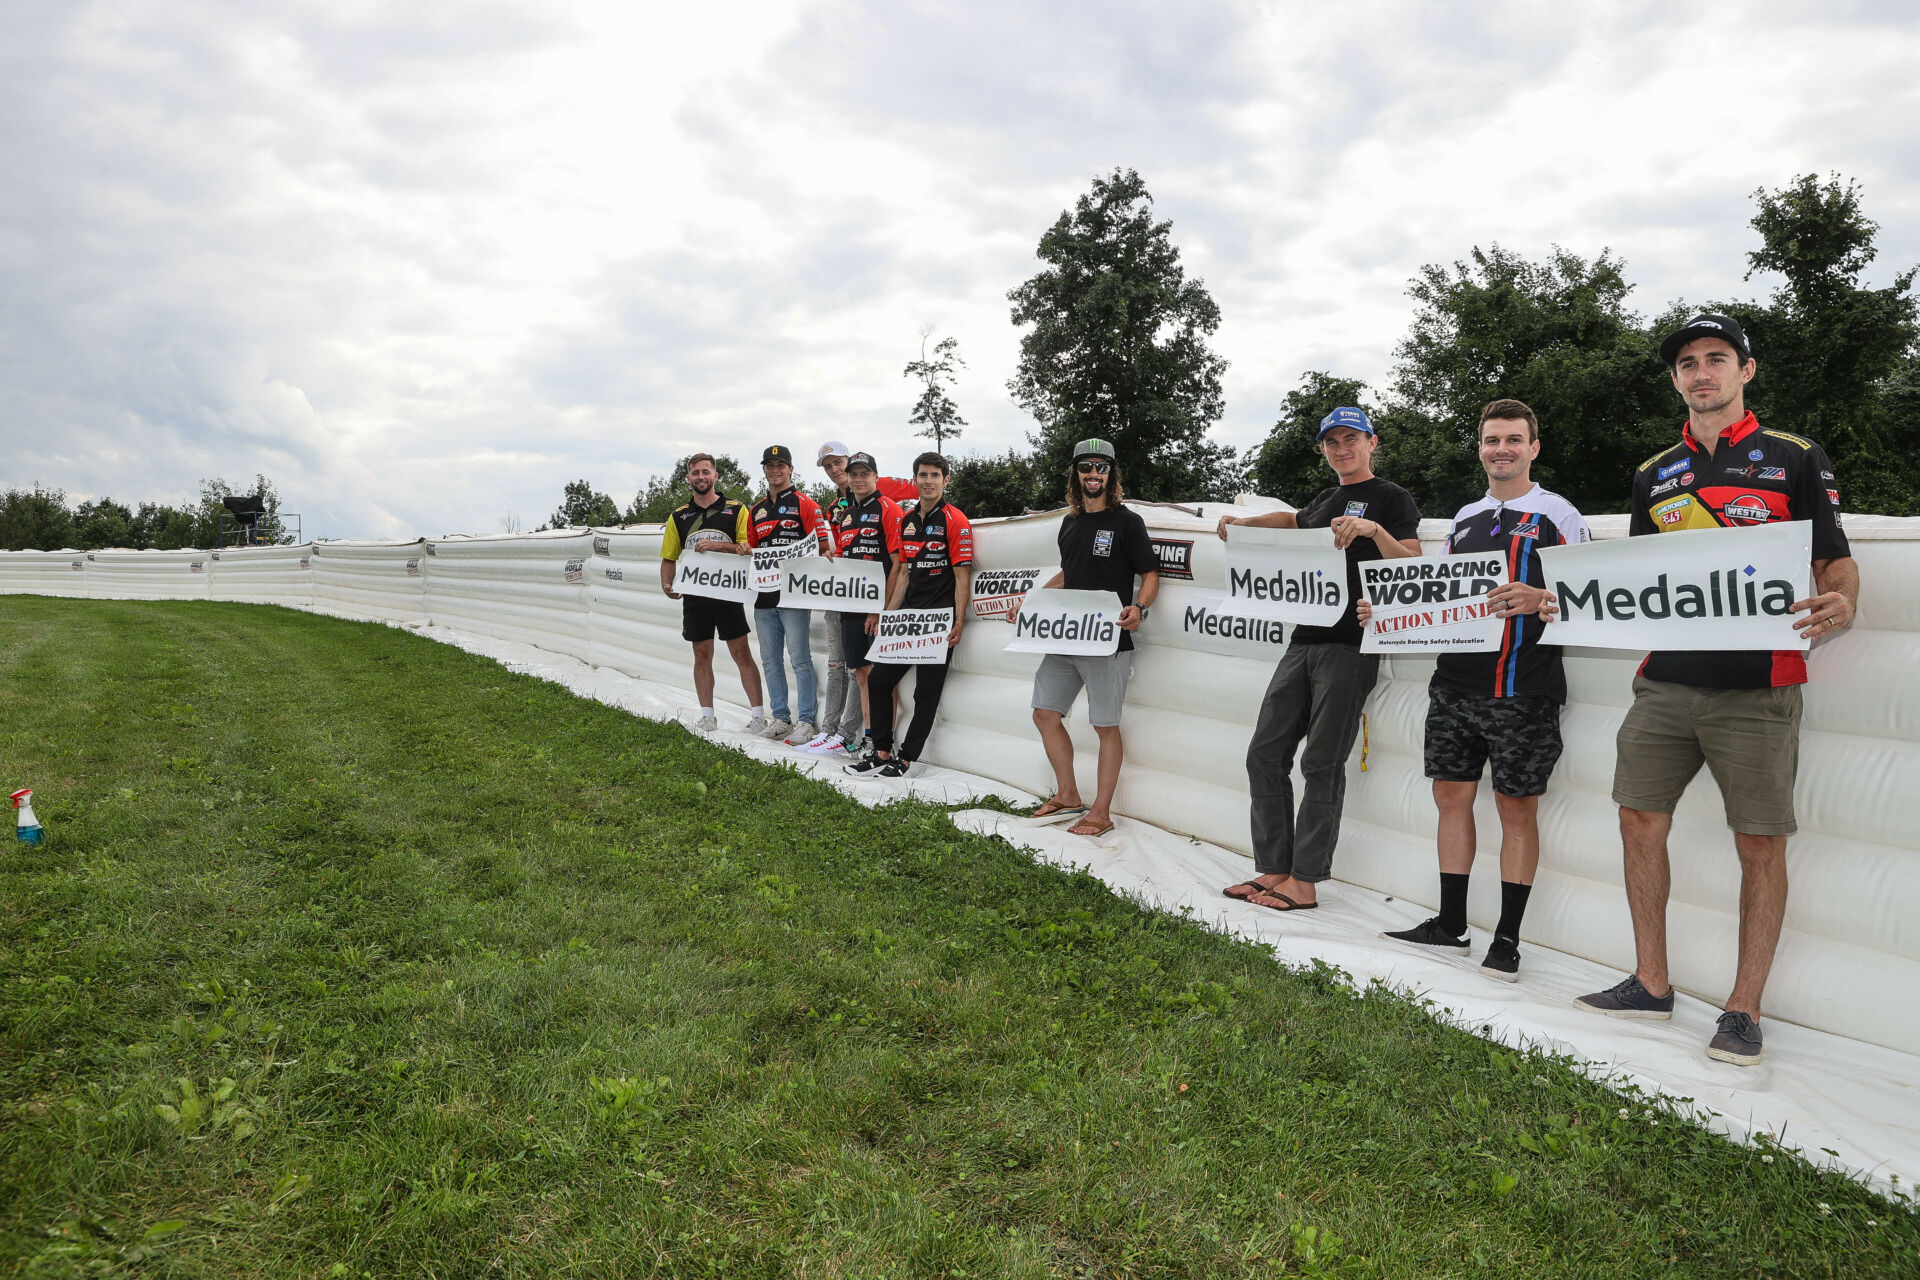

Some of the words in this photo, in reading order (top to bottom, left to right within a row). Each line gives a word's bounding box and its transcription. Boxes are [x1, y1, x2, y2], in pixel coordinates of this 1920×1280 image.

[1661, 499, 1689, 511] MOTOREX
[1727, 507, 1767, 520] WESTBY
[754, 536, 817, 560] ROADRACING
[852, 546, 880, 554] SUZUKI
[917, 560, 948, 569] SUZUKI
[1364, 560, 1502, 584] ROADRACING
[681, 566, 752, 590] Medalli
[977, 569, 1040, 580] ROADRACING
[788, 573, 880, 600] Medallia
[974, 579, 1034, 595] WORLD
[1230, 568, 1341, 607] Medallia
[1367, 579, 1499, 606] WORLD
[1556, 565, 1796, 622] Medallia
[975, 600, 1004, 613] ACTION
[881, 613, 950, 624] ROADRACING
[1016, 612, 1115, 642] Medallia
[1374, 612, 1434, 635] ACTION
[880, 623, 948, 637] WORLD
[877, 640, 914, 653] ACTION
[917, 636, 943, 648] FUND
